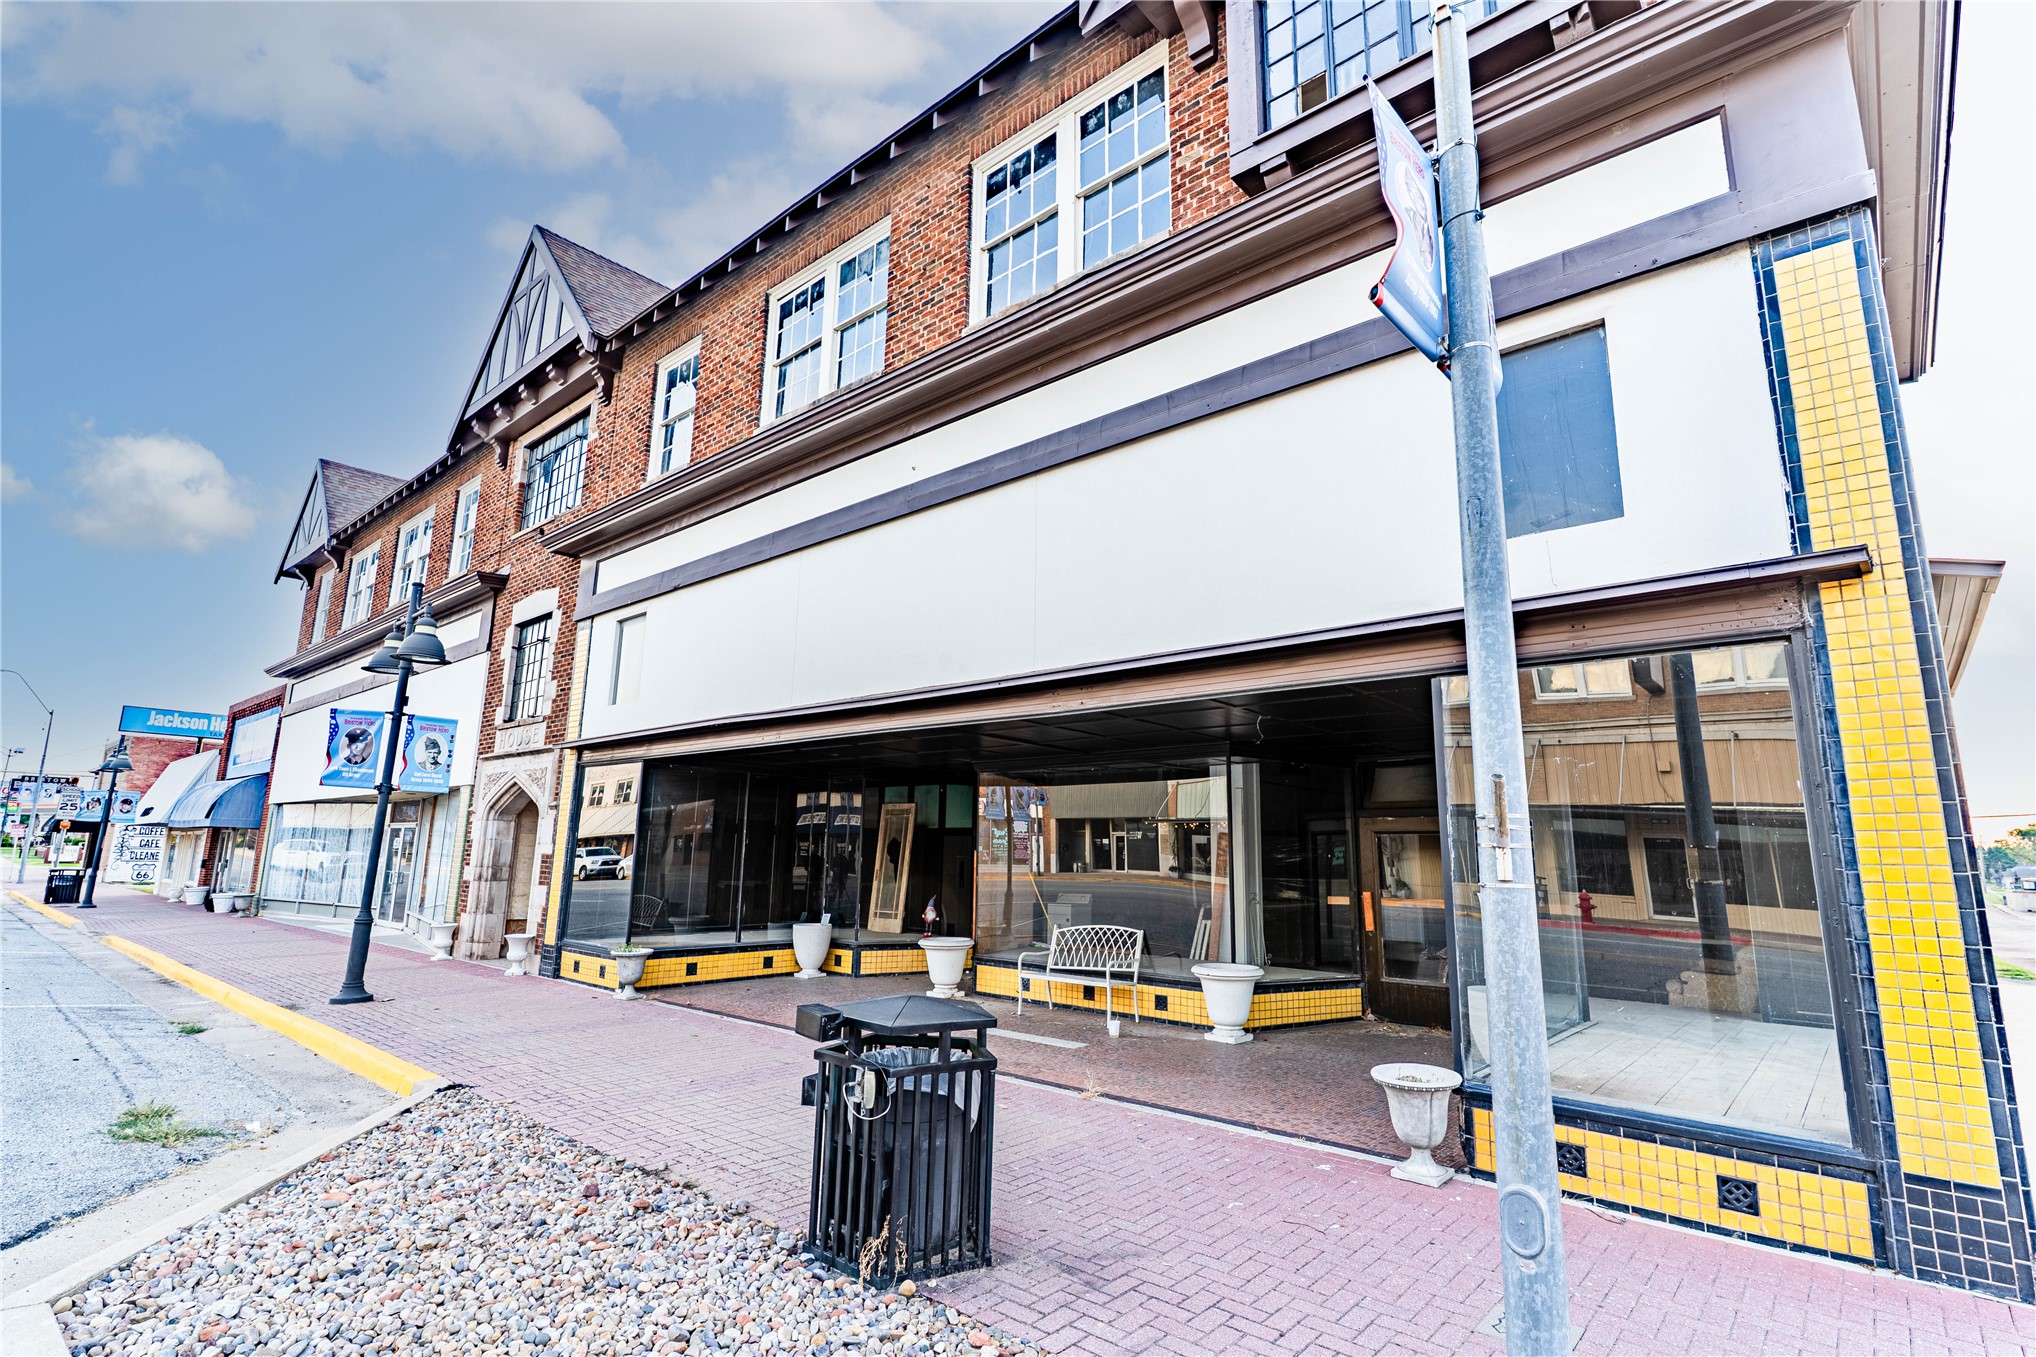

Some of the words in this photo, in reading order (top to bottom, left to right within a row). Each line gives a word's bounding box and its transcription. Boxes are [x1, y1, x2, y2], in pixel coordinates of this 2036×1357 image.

[146, 710, 209, 731] Jackson
[499, 727, 540, 749] HOUSE
[59, 802, 78, 811] 25
[139, 838, 161, 848] CAFE
[136, 871, 149, 879] 66
